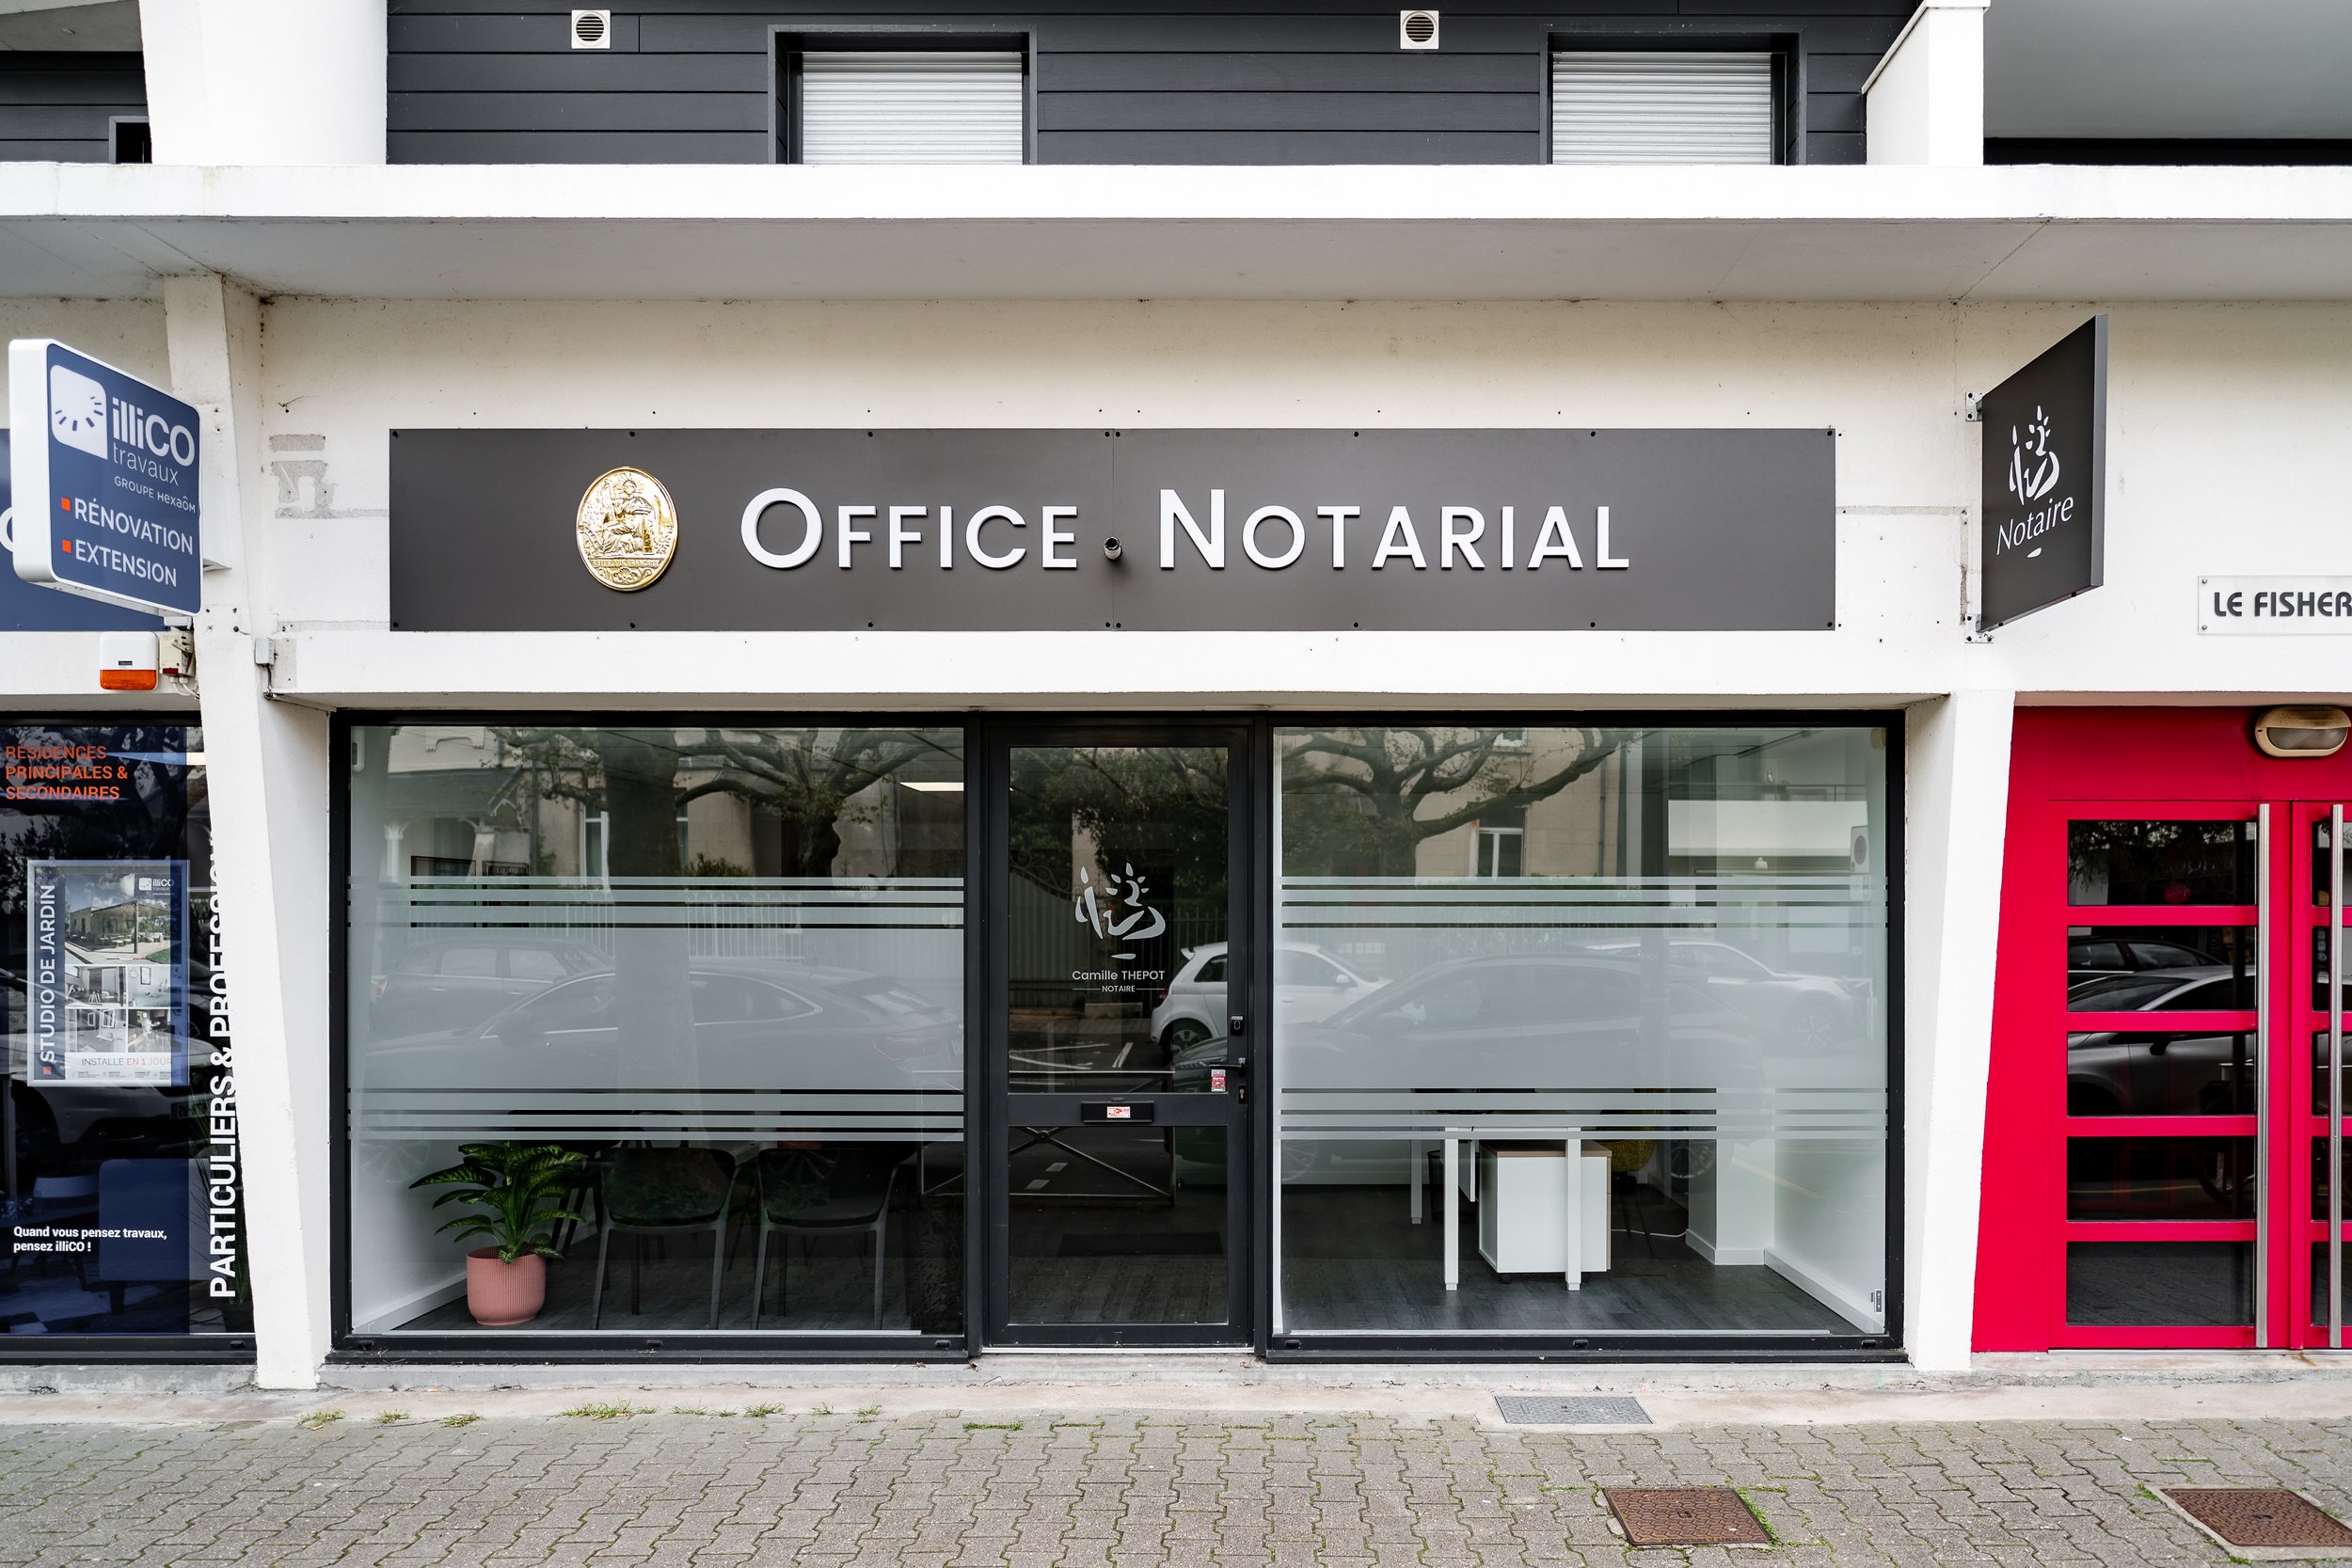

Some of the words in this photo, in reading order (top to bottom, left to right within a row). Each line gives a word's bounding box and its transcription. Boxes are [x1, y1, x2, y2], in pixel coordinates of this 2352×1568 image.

[112, 396, 196, 467] illiCO
[113, 442, 180, 486] travaux
[114, 475, 154, 499] GROUPE
[74, 497, 194, 556] RÉNOVATION
[740, 486, 1079, 570] OFFICE
[1159, 488, 1630, 570] NOTARIAL
[1996, 496, 2074, 556] Notaire
[75, 538, 177, 588] EXTENSION
[2214, 592, 2243, 617] LE
[2254, 591, 2352, 617] FISHER
[5, 765, 113, 780] PRINCIPALES
[116, 765, 129, 780] &
[5, 785, 120, 800] SECONDAIRES
[40, 885, 56, 955] JARDIN
[40, 958, 56, 984] DE
[1072, 970, 1119, 980] Camille
[1120, 970, 1166, 980] THEPOT
[40, 989, 56, 1063] STUDIO
[126, 1057, 139, 1066] EN
[141, 1057, 147, 1066] 1
[210, 1046, 234, 1069] &
[210, 1075, 236, 1298] PARTICULIERS
[13, 1226, 50, 1238] Quand
[52, 1228, 79, 1238] vous
[81, 1228, 121, 1240] pensez
[123, 1227, 167, 1241] travaux,
[13, 1242, 54, 1254] pensez
[56, 1241, 86, 1252] illiCO
[87, 1241, 92, 1252] !
